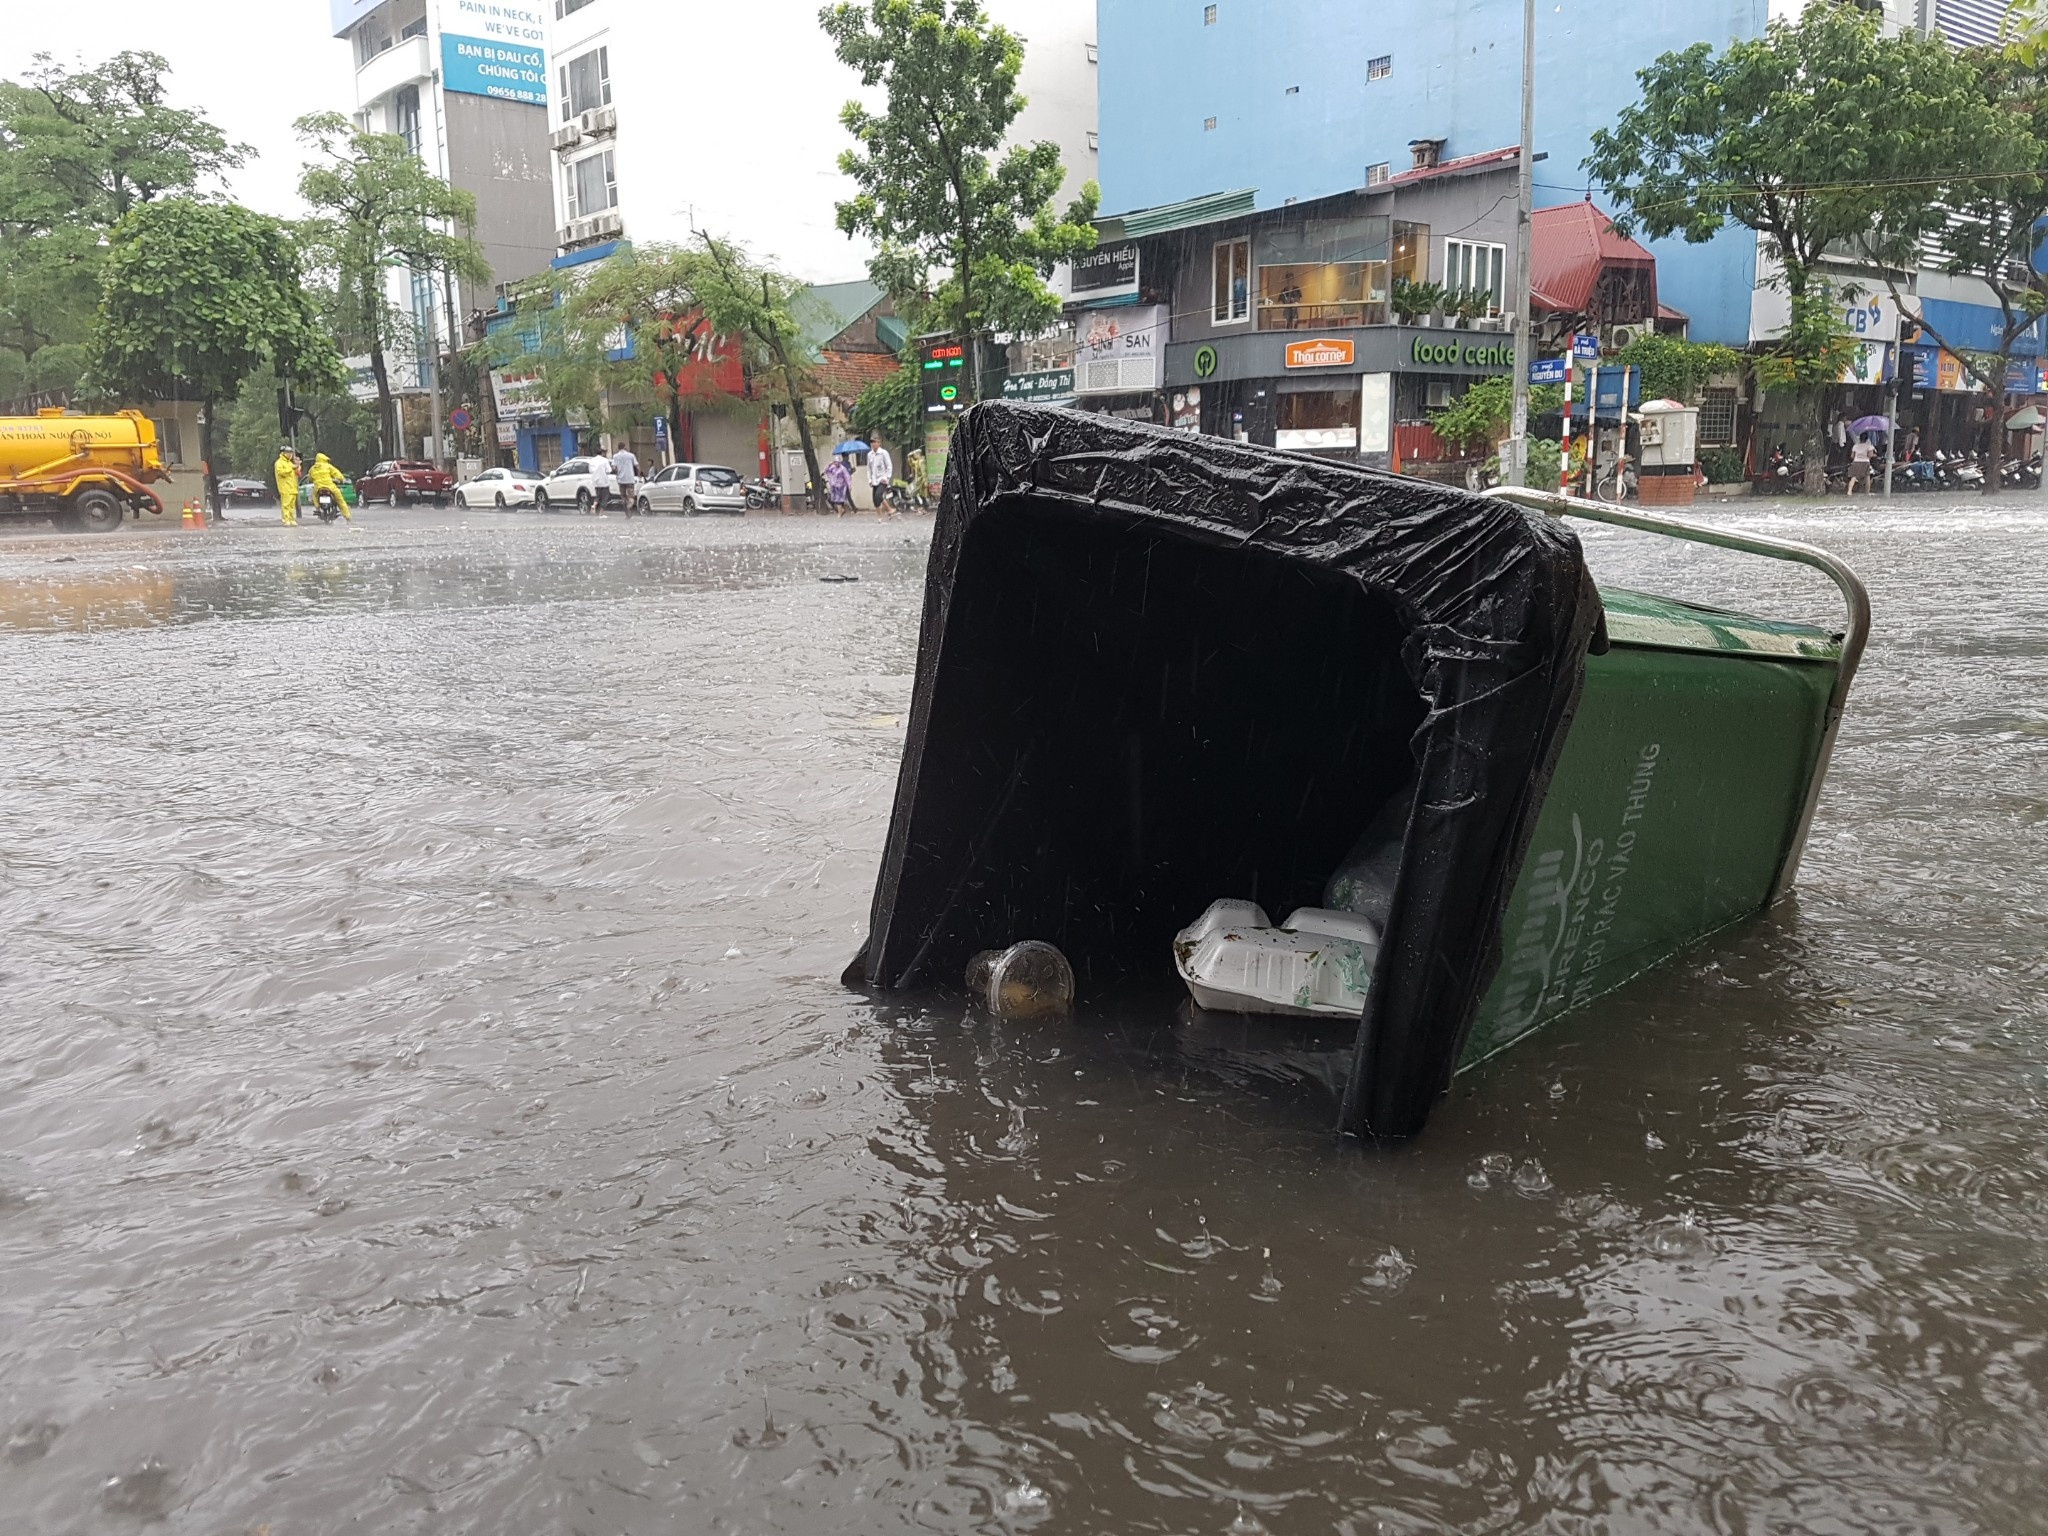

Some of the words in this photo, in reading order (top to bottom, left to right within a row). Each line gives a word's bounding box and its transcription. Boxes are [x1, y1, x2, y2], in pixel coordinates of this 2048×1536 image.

[460, 1, 486, 15] PAIN
[489, 6, 501, 17] IN
[503, 8, 535, 24] NECK,
[485, 22, 520, 37] WE'VE
[457, 43, 482, 59] BẠN
[484, 47, 495, 62] BỊ
[497, 50, 521, 63] ĐAU
[478, 64, 519, 80] CHÚNG
[520, 69, 539, 83] TÔI
[487, 85, 516, 98] 09656
[517, 88, 534, 101] 888
[1112, 244, 1135, 263] HIẾU
[1126, 334, 1151, 348] SAN
[1412, 335, 1460, 363] food
[1464, 340, 1515, 365] cente
[1606, 830, 1637, 882] VÀO
[1622, 743, 1661, 826] THÙNG
